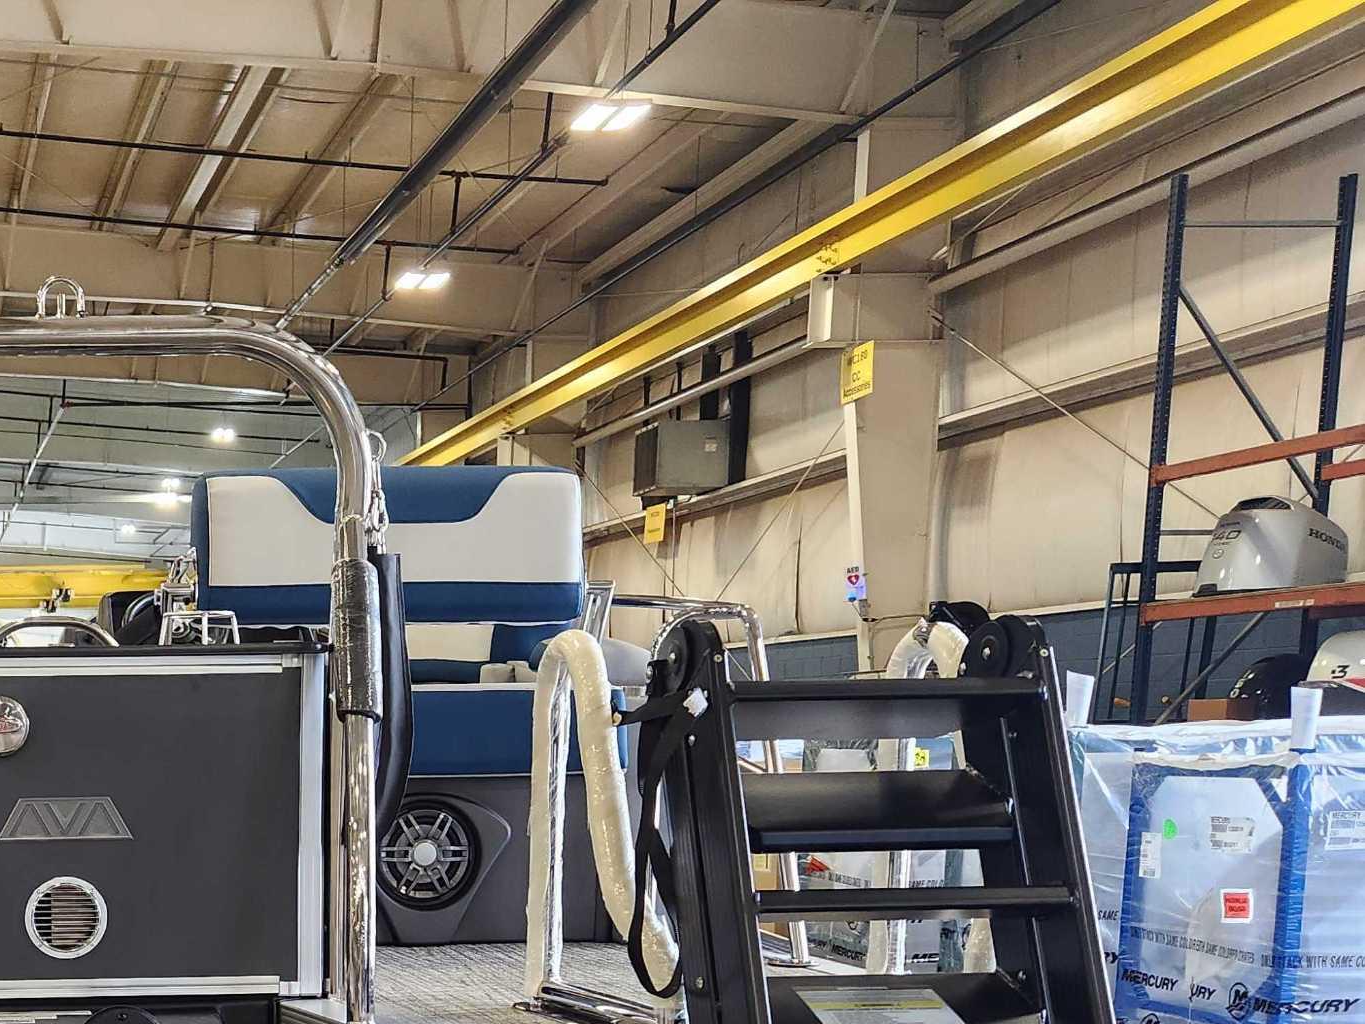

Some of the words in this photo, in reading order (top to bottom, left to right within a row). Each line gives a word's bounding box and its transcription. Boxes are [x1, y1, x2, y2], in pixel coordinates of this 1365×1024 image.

[1306, 954, 1328, 969] WITH
[1330, 954, 1355, 969] SAME
[1121, 968, 1179, 992] MERCURY
[1251, 998, 1362, 1015] MERCURY
